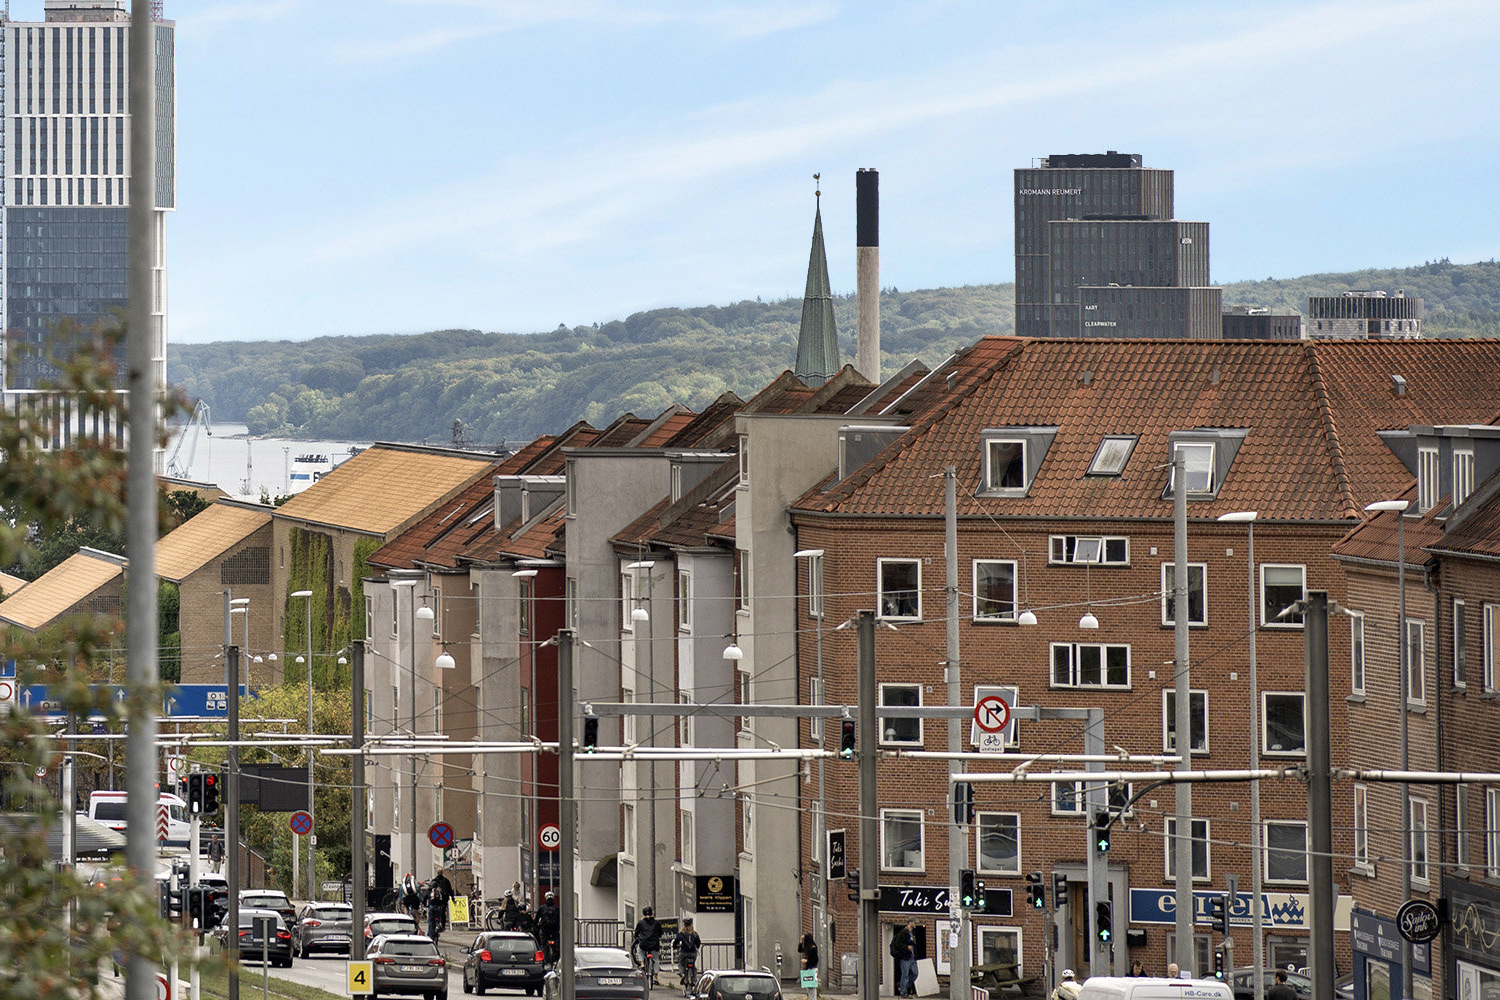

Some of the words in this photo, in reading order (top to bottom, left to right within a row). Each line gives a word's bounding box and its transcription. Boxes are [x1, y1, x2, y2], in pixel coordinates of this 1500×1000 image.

[1019, 188, 1051, 196] KROMANN
[1051, 188, 1082, 196] REUMERT
[542, 831, 560, 843] 60
[900, 889, 931, 907] Toki
[1401, 912, 1435, 932] Sailor
[1414, 921, 1429, 933] ink
[353, 970, 367, 985] 4
[1184, 990, 1223, 998] HB-Care.dk
